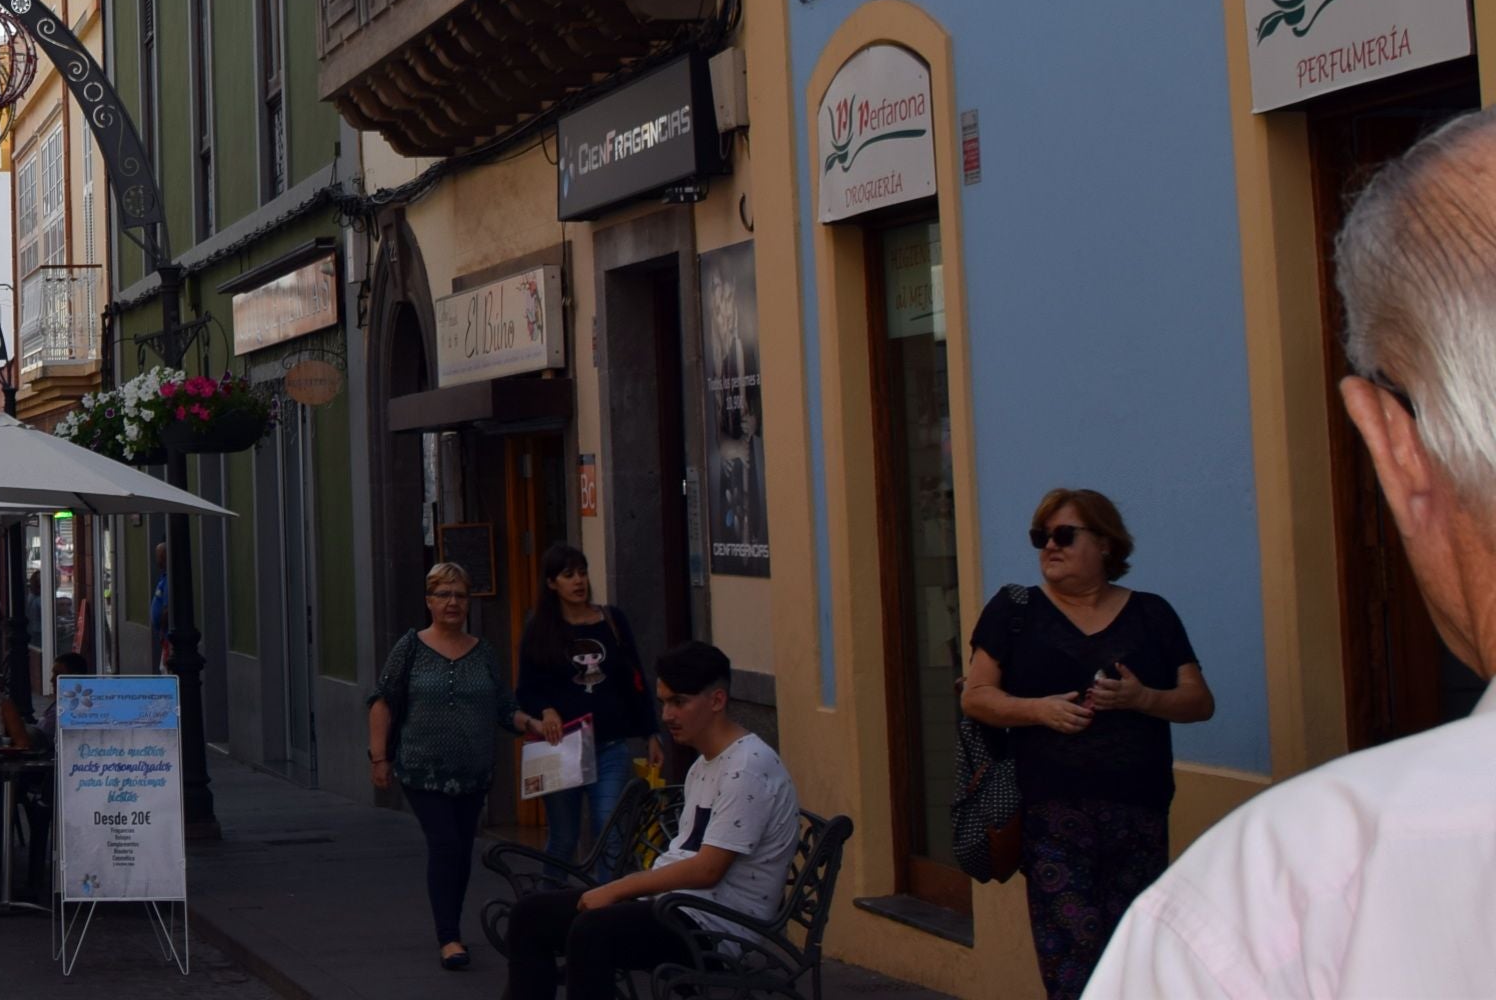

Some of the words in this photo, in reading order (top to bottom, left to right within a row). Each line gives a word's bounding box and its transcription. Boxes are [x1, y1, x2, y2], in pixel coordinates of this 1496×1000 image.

[1297, 25, 1412, 88] PERFUMERÍA
[858, 93, 925, 136] Perfarona
[844, 170, 903, 208] DROGUERÍA
[464, 292, 479, 358] El
[482, 284, 516, 354] Búho
[581, 473, 595, 509] Bc
[71, 761, 100, 776] packs
[100, 761, 171, 776] personalizados
[94, 811, 127, 825] Desde
[131, 811, 151, 825] 20€
